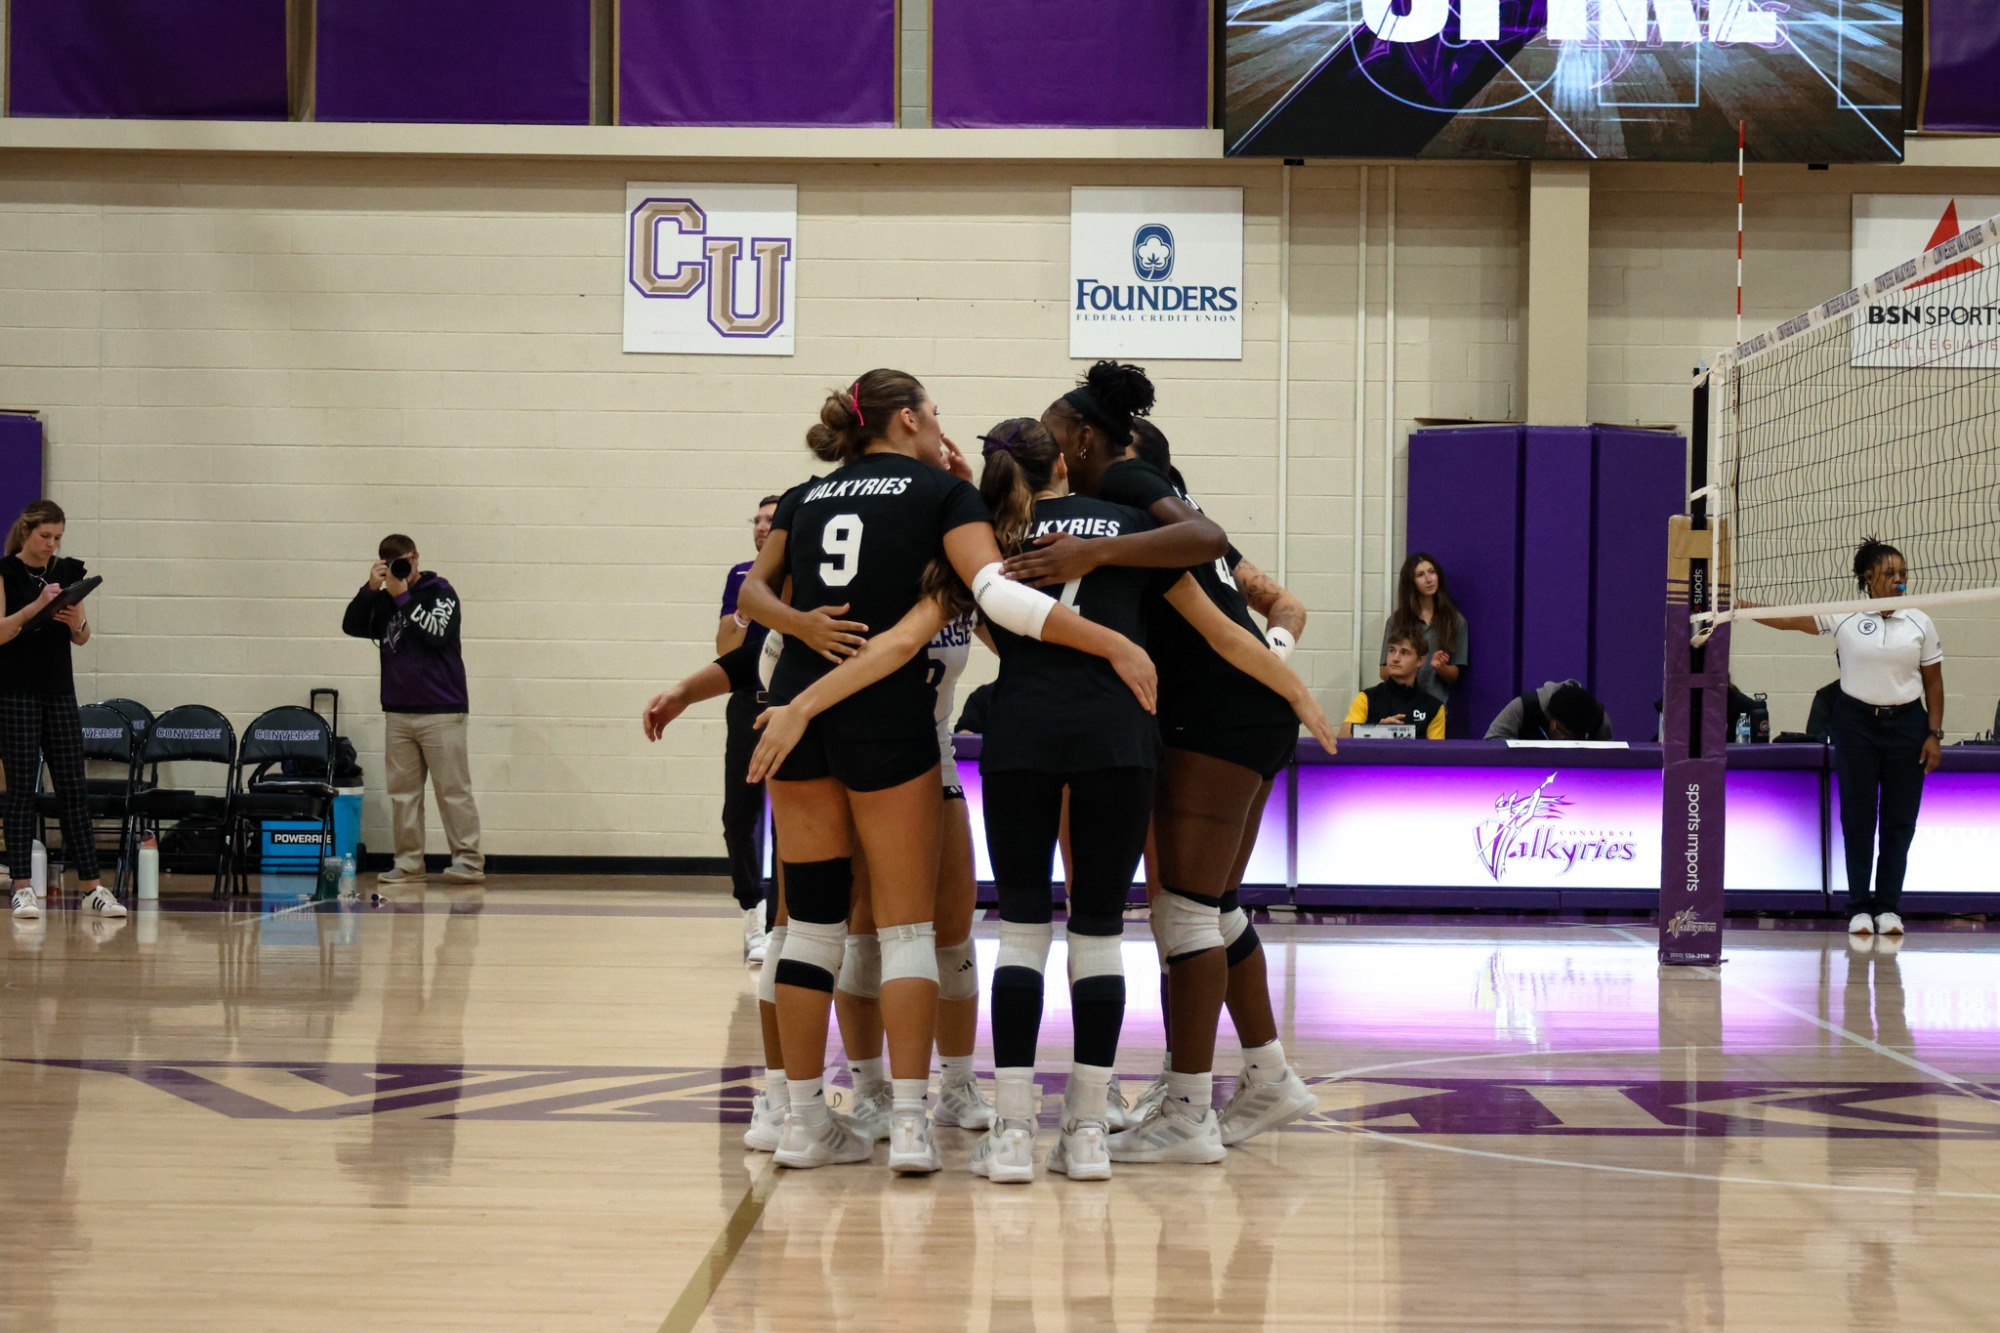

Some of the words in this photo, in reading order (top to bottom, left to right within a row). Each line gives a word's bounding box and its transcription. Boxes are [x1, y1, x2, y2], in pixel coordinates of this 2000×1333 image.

[629, 197, 792, 338] CU
[1076, 314, 1134, 322] FEDERAL
[1141, 314, 1188, 322] CREDIT
[1196, 314, 1236, 322] UNION
[1868, 306, 1921, 325] BSN
[1925, 306, 2000, 325] SPORT
[803, 477, 913, 504] VALKYRIES
[1026, 518, 1121, 539] LKYRIES
[819, 514, 864, 587] 9
[82, 727, 124, 739] VERSE
[155, 728, 222, 740] CONVERSE
[254, 729, 320, 741] CONVERSE
[1685, 783, 1701, 831] sports
[1472, 818, 1637, 883] Valkyries
